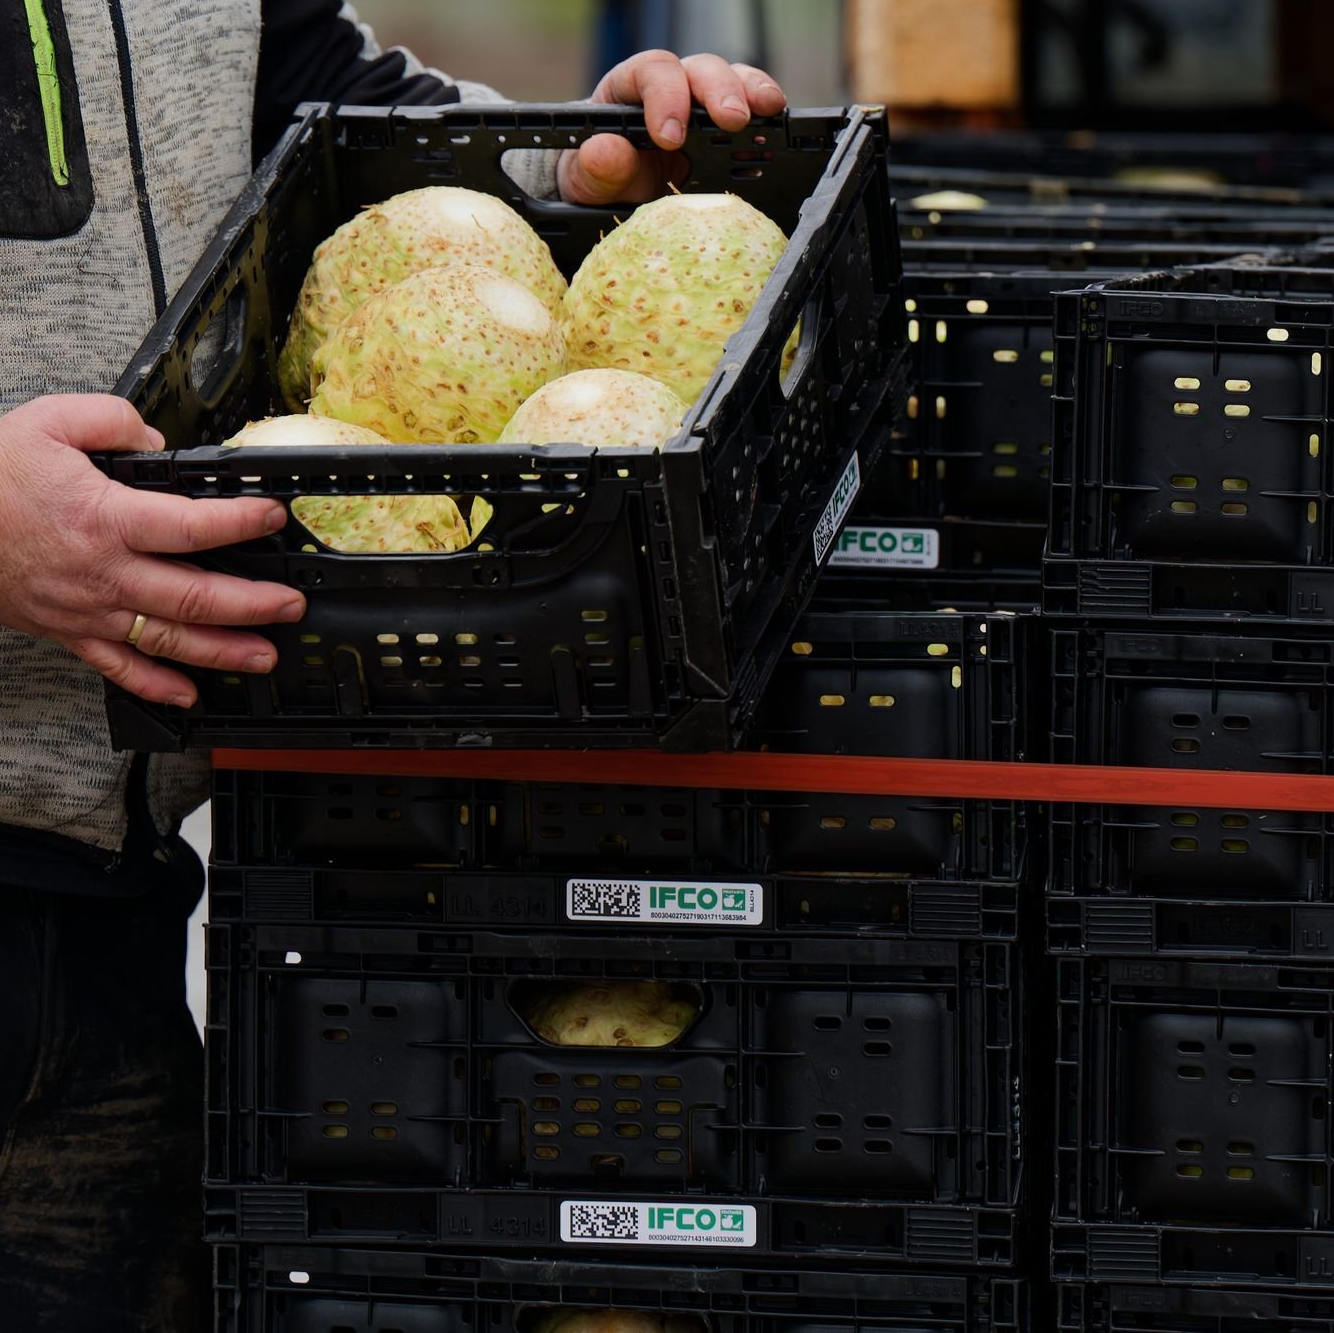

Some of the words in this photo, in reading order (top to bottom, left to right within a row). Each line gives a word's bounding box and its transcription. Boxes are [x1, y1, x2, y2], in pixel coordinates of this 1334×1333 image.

[833, 473, 850, 518] IFCO
[650, 886, 718, 910] IFCO
[1298, 929, 1329, 951] LL
[648, 1207, 716, 1230] IFCO
[1305, 1256, 1334, 1278] LL
